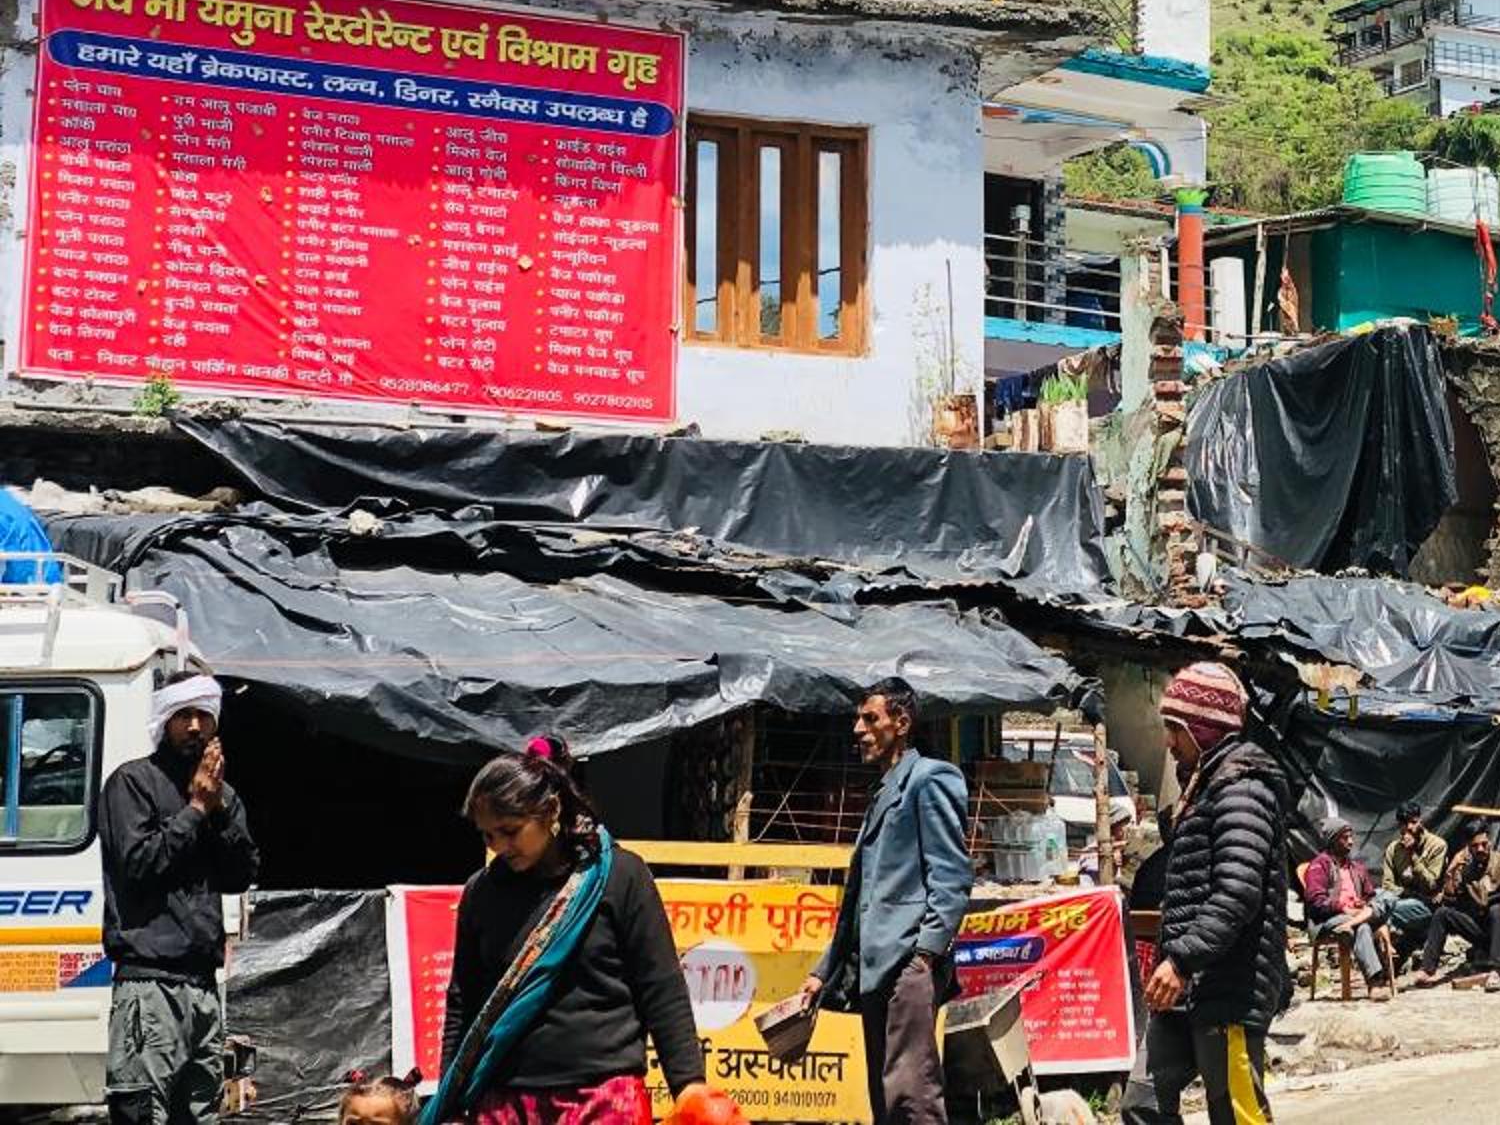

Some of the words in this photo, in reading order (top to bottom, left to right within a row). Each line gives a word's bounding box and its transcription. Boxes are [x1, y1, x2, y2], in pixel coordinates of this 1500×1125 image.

[76, 42, 142, 66] हमारे
[147, 52, 199, 74] यहाँ
[467, 91, 537, 115] स्नैक्स
[545, 101, 624, 125] उपलब्ध
[630, 107, 648, 128] है
[303, 0, 434, 54] रेस्टोरेन्ट
[440, 23, 490, 61] एवं
[497, 25, 600, 73] विश्राम
[607, 47, 661, 90] गृह
[716, 1048, 850, 1084] अस्पताल
